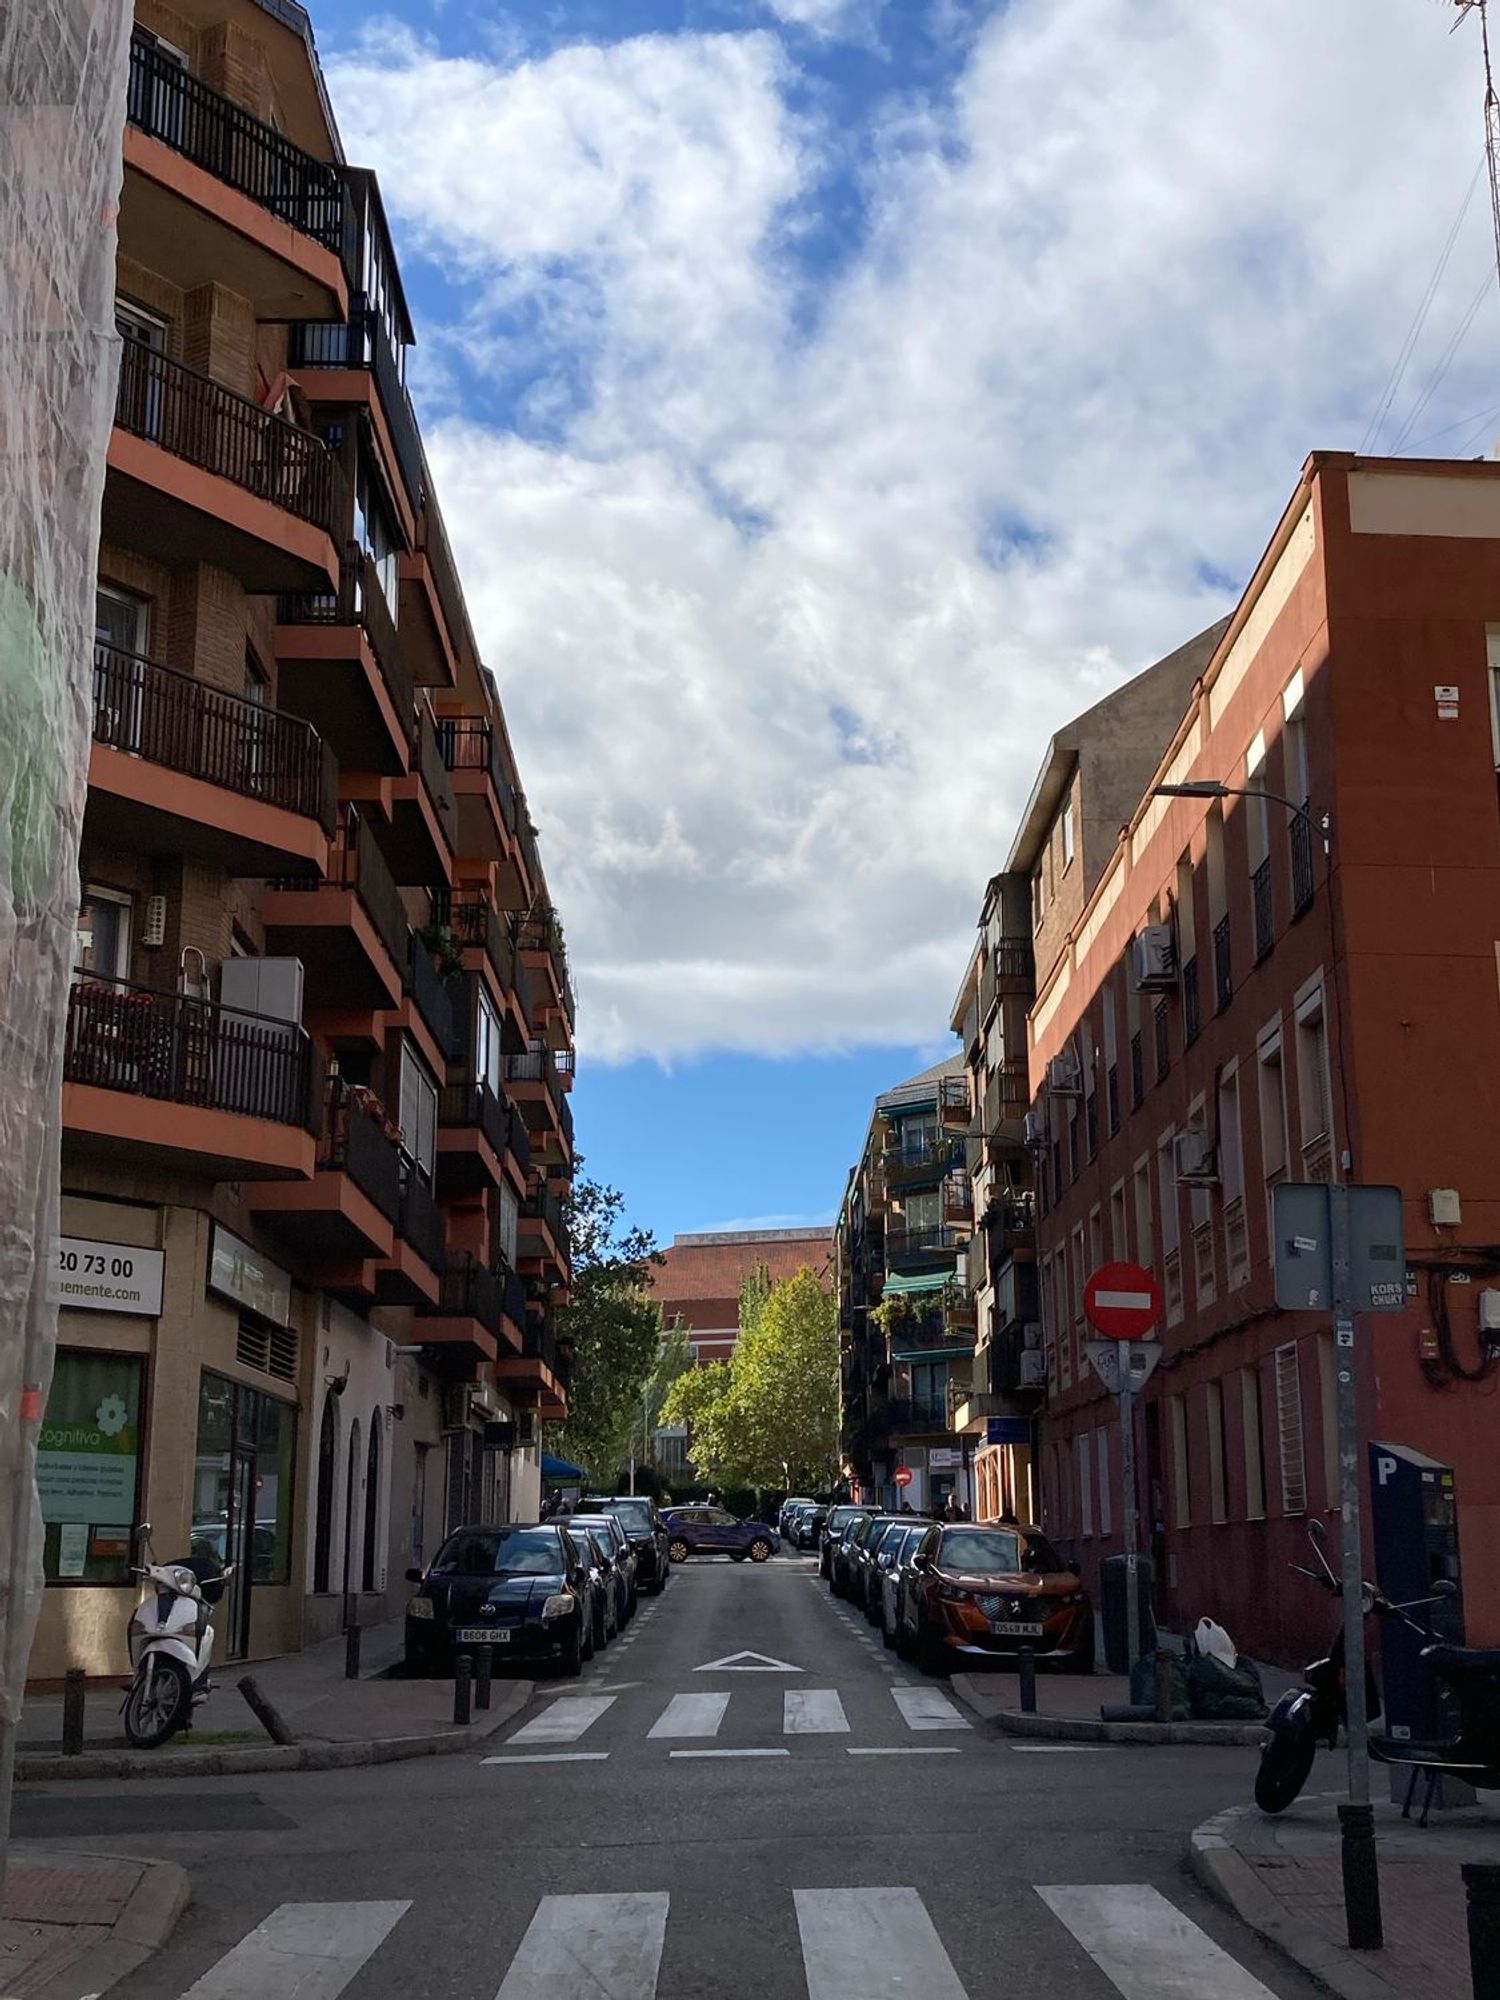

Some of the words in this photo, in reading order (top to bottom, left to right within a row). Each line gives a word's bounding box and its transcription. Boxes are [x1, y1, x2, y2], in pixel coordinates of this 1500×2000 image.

[84, 1254, 106, 1275] 73
[111, 1258, 133, 1278] 00
[1370, 1283, 1403, 1295] KORS
[1371, 1293, 1404, 1306] CHUKY
[1377, 1457, 1398, 1485] P
